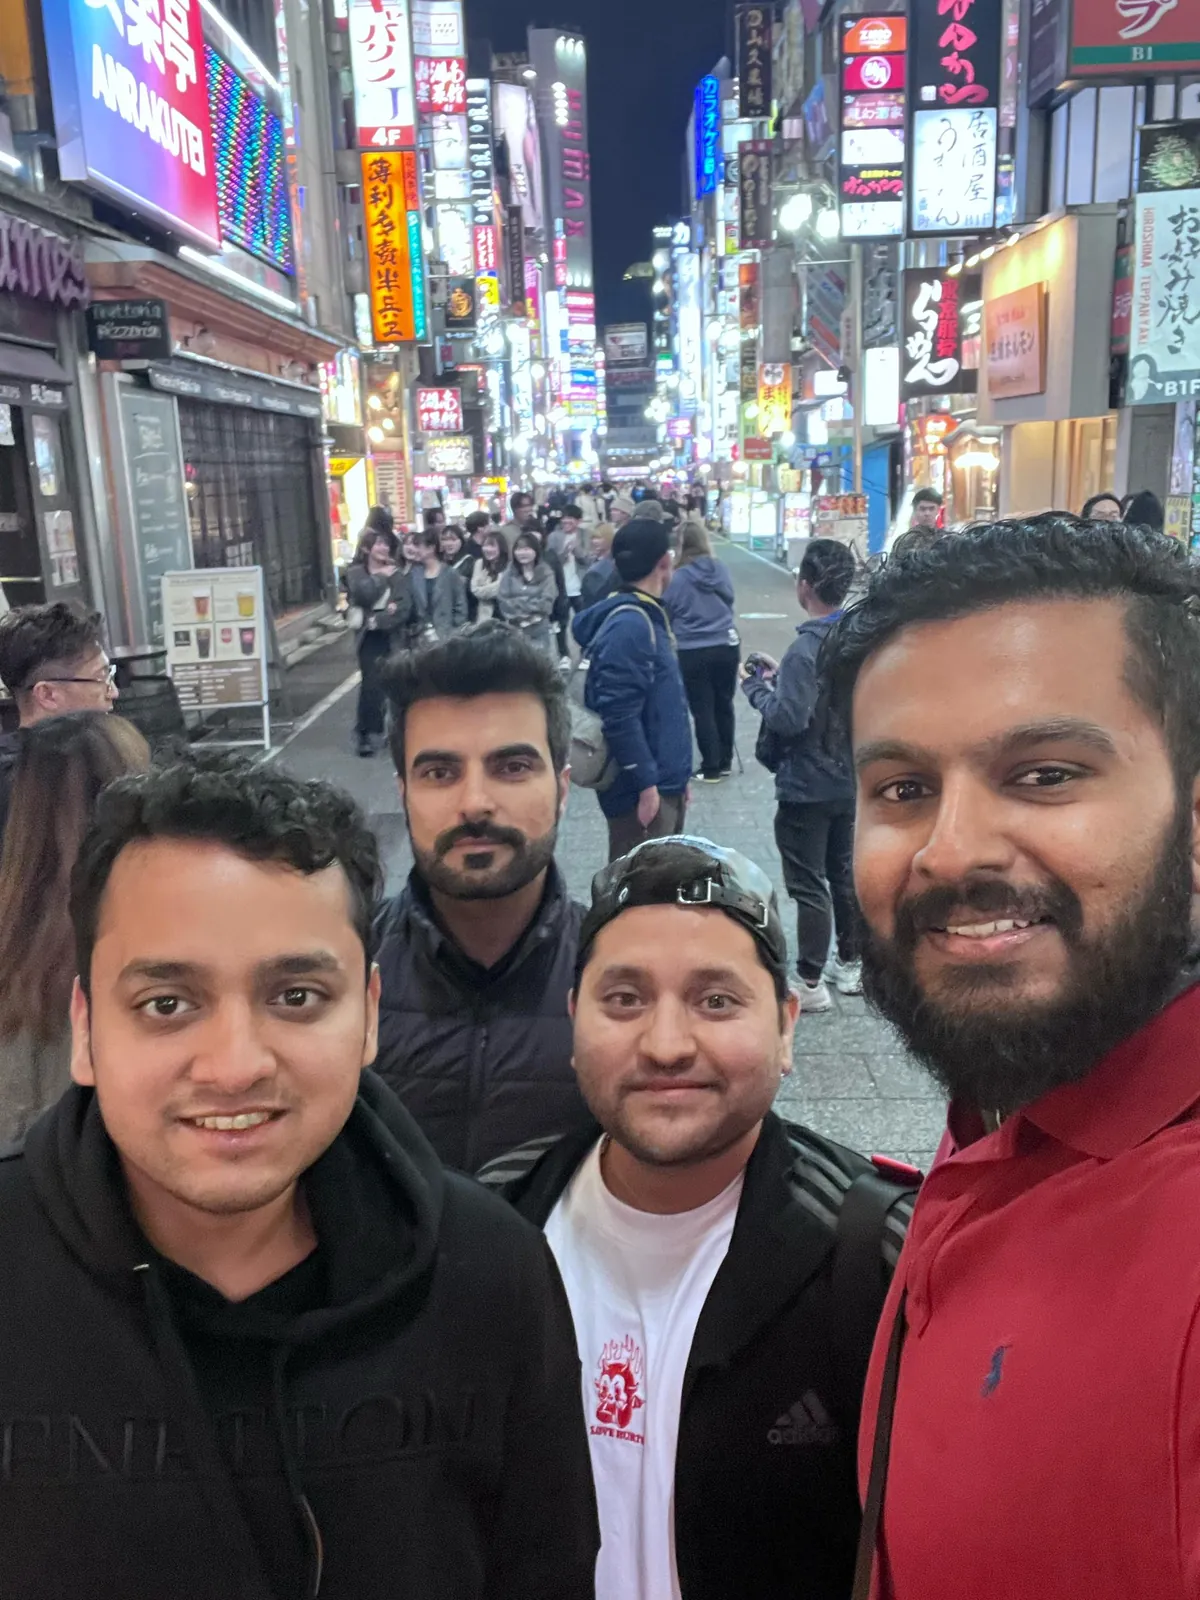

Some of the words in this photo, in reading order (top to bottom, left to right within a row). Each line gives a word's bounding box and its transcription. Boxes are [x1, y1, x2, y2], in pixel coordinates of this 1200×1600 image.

[1131, 46, 1153, 61] B1
[371, 127, 401, 146] 4F
[1142, 206, 1155, 268] HIROSHIMA
[1156, 204, 1200, 355] お好み焼き
